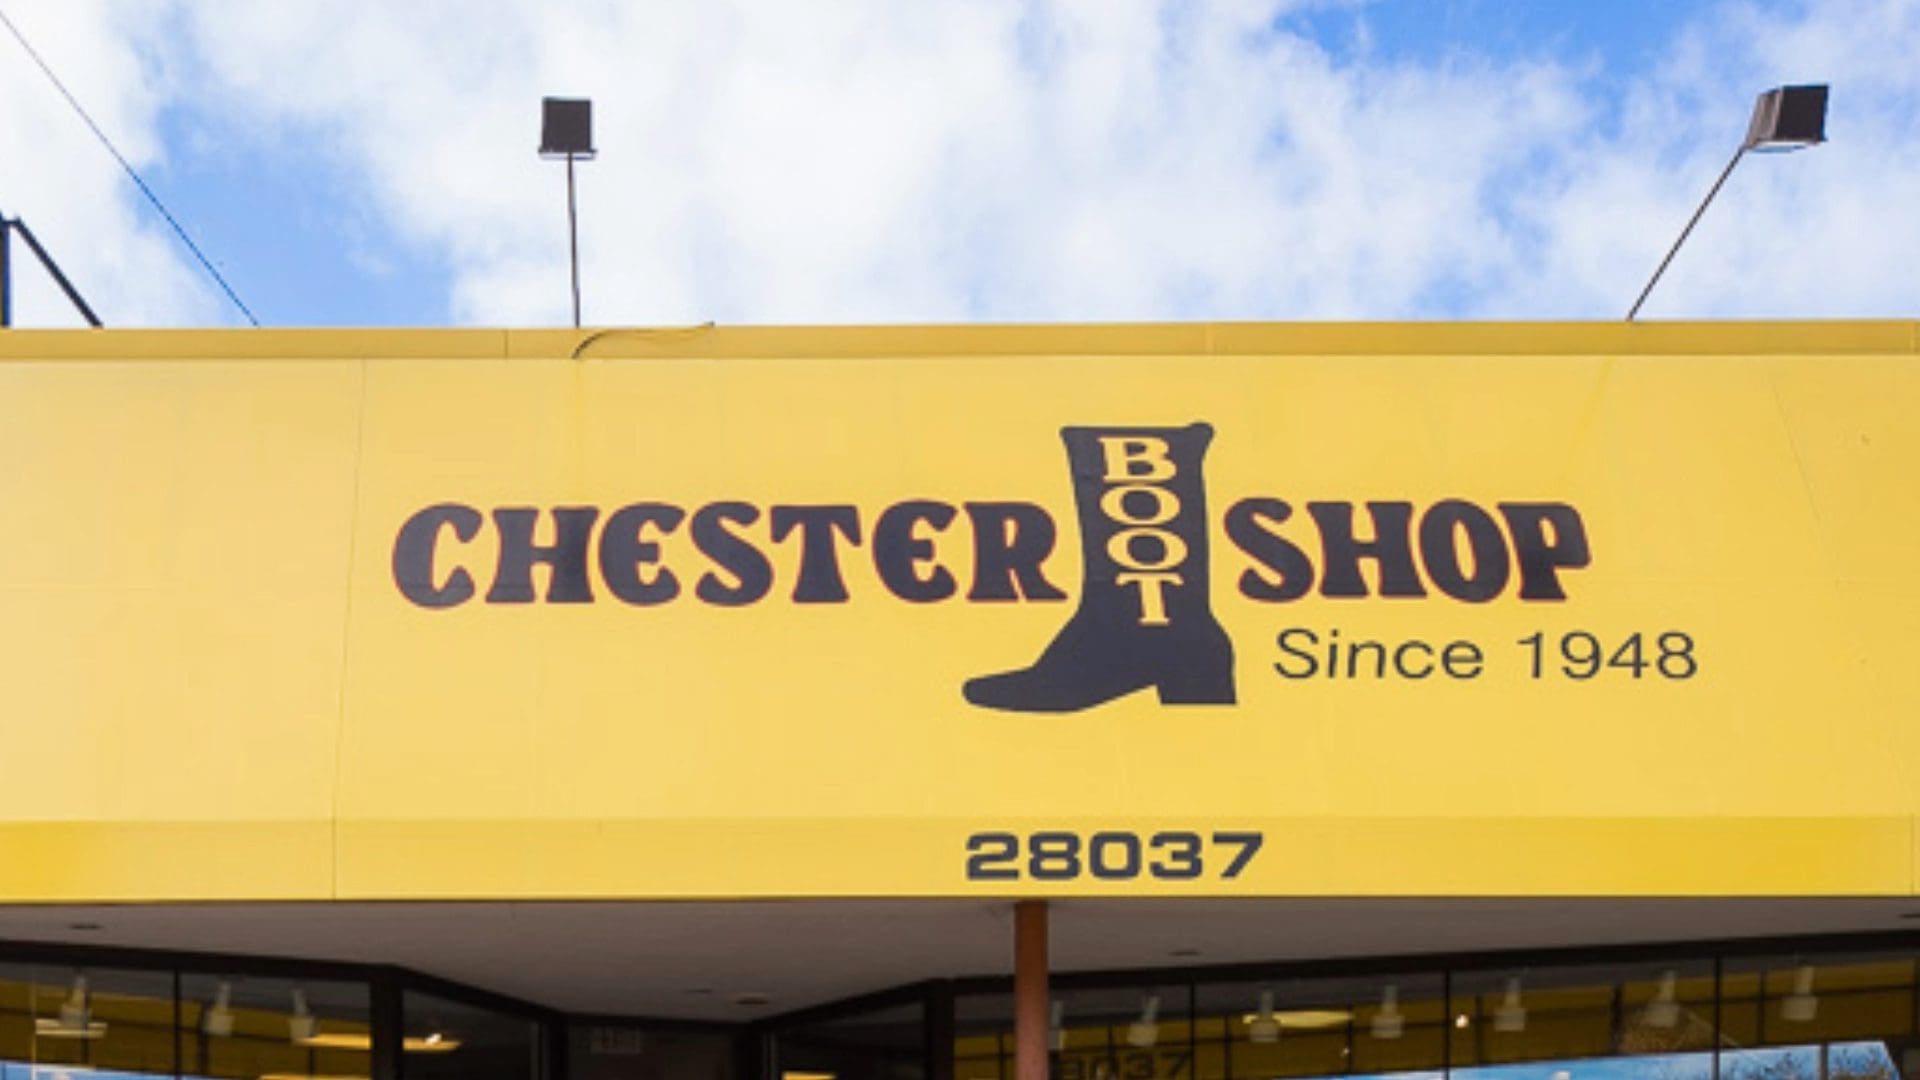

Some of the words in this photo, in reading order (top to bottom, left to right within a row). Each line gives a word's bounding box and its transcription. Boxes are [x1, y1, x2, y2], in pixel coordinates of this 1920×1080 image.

[391, 501, 1068, 608] CHESTER
[1223, 498, 1592, 604] SHOP
[1098, 436, 1188, 626] BOOT
[1274, 628, 1484, 680] Since
[1518, 631, 1698, 680] 1948
[965, 831, 1264, 881] 28037
